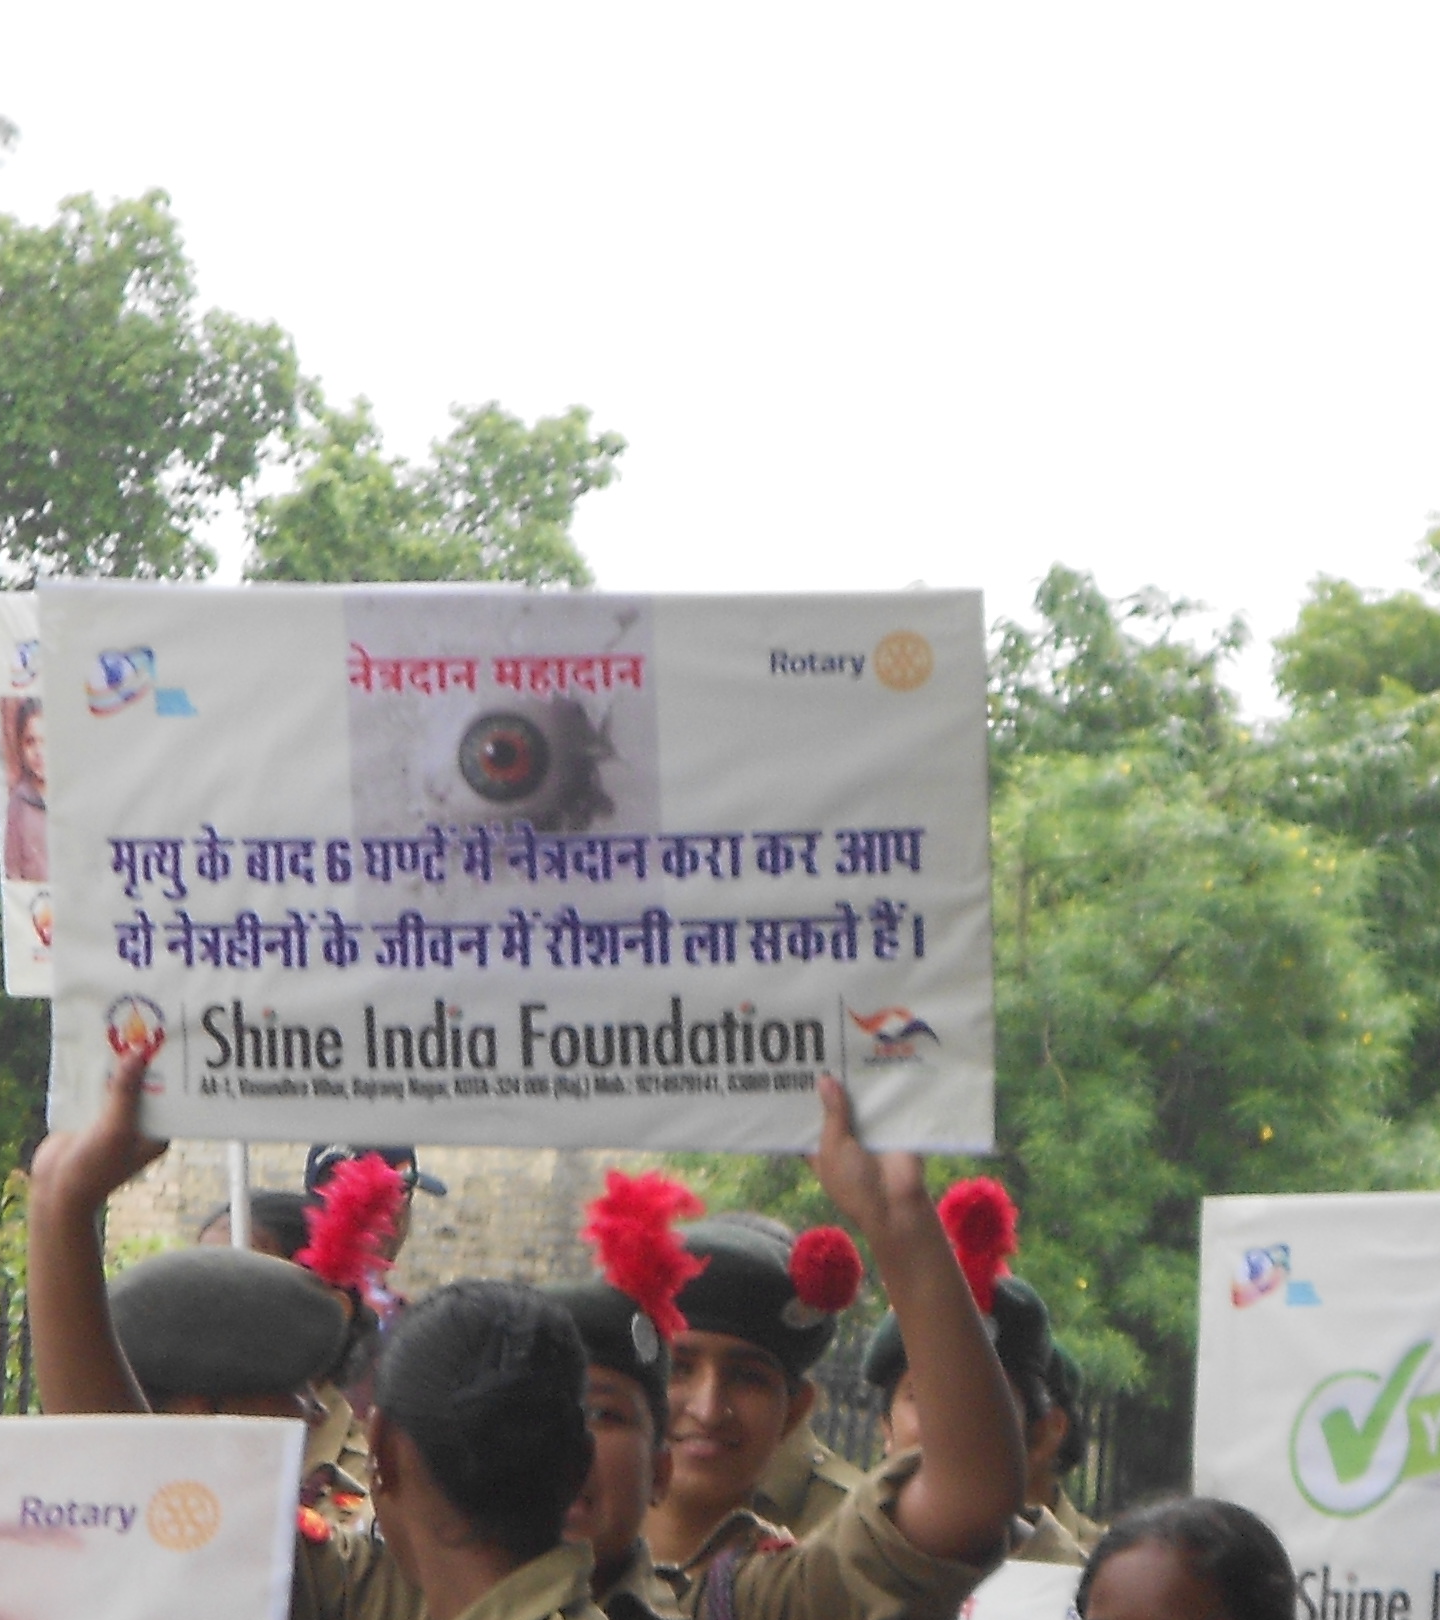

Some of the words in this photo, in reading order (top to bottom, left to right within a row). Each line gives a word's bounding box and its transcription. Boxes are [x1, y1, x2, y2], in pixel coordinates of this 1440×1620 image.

[346, 641, 480, 696] नेत्रदान
[492, 652, 647, 697] महादान
[768, 648, 866, 683] Rotary
[107, 836, 191, 899] मृत्यु
[192, 824, 235, 884] के
[241, 835, 317, 885] बाद
[324, 838, 352, 884] 6
[460, 822, 503, 883] में
[504, 821, 651, 883] नेत्रदान
[658, 831, 745, 879] करा
[752, 829, 823, 878] कर
[834, 826, 926, 876] आप
[113, 909, 157, 970] दो
[163, 908, 319, 970] नेत्रहीनों
[320, 908, 363, 970] के
[371, 907, 493, 970] जीवन
[499, 906, 544, 968] में
[679, 917, 741, 965] ला
[746, 900, 862, 965] सकते
[199, 997, 345, 1071] Shine
[363, 997, 498, 1071] India
[518, 994, 826, 1070] Foundation
[20, 1495, 137, 1534] Rotary
